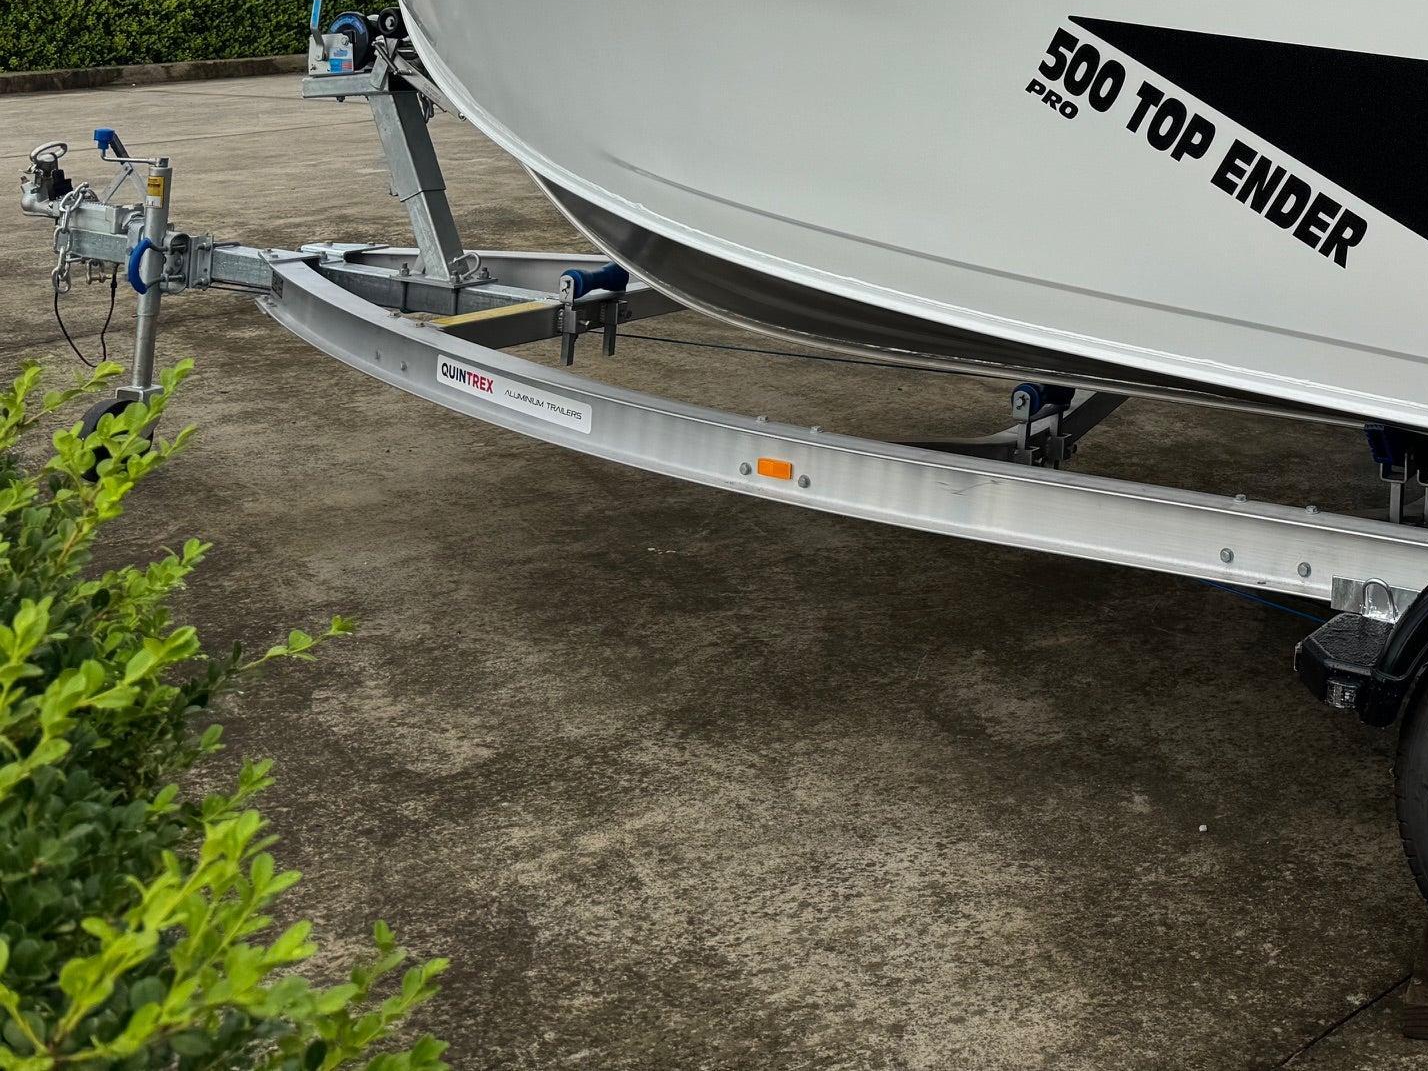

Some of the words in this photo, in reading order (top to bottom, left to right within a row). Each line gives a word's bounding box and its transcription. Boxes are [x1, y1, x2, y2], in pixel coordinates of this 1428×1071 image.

[1025, 78, 1079, 120] PRO
[1038, 27, 1126, 113] 500
[1125, 80, 1216, 162] TOP
[1210, 138, 1368, 269] ENDER
[441, 362, 494, 394] QUINTREX
[504, 389, 544, 408] ALUMINIUM
[547, 402, 582, 420] TRAILERS
